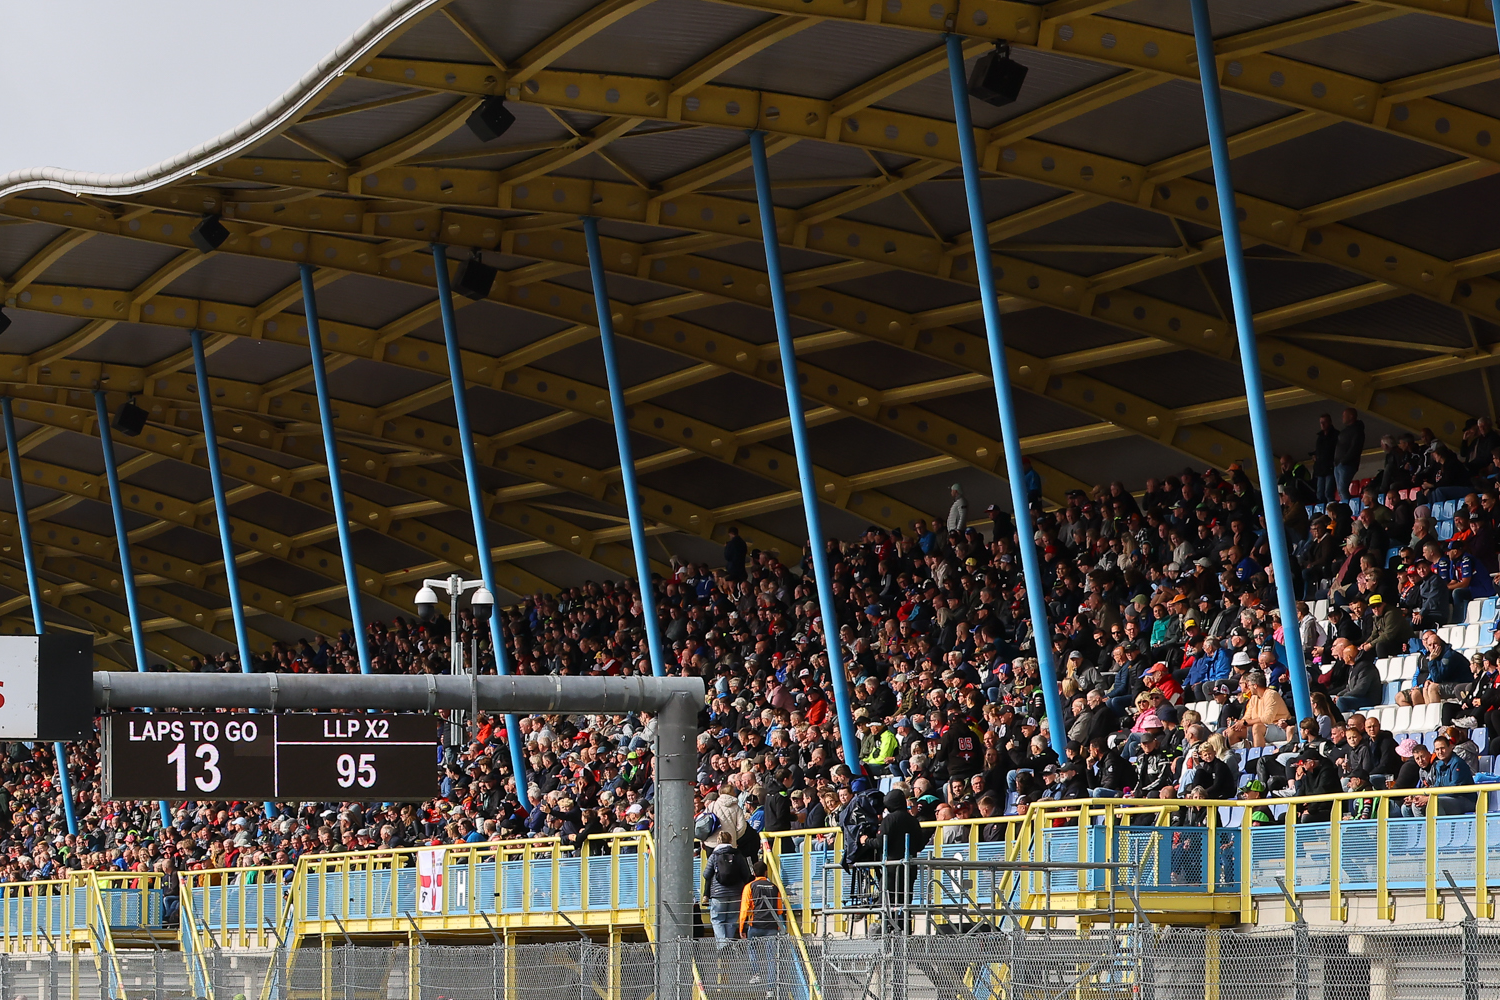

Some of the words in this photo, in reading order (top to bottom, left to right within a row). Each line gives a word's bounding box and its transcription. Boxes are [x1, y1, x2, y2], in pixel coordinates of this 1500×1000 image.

[129, 721, 184, 741] LAPS
[190, 721, 219, 741] TO
[225, 721, 258, 742] GO
[324, 719, 360, 738] LLP
[365, 719, 389, 738] X2
[167, 743, 222, 792] 13
[336, 753, 376, 788] 95
